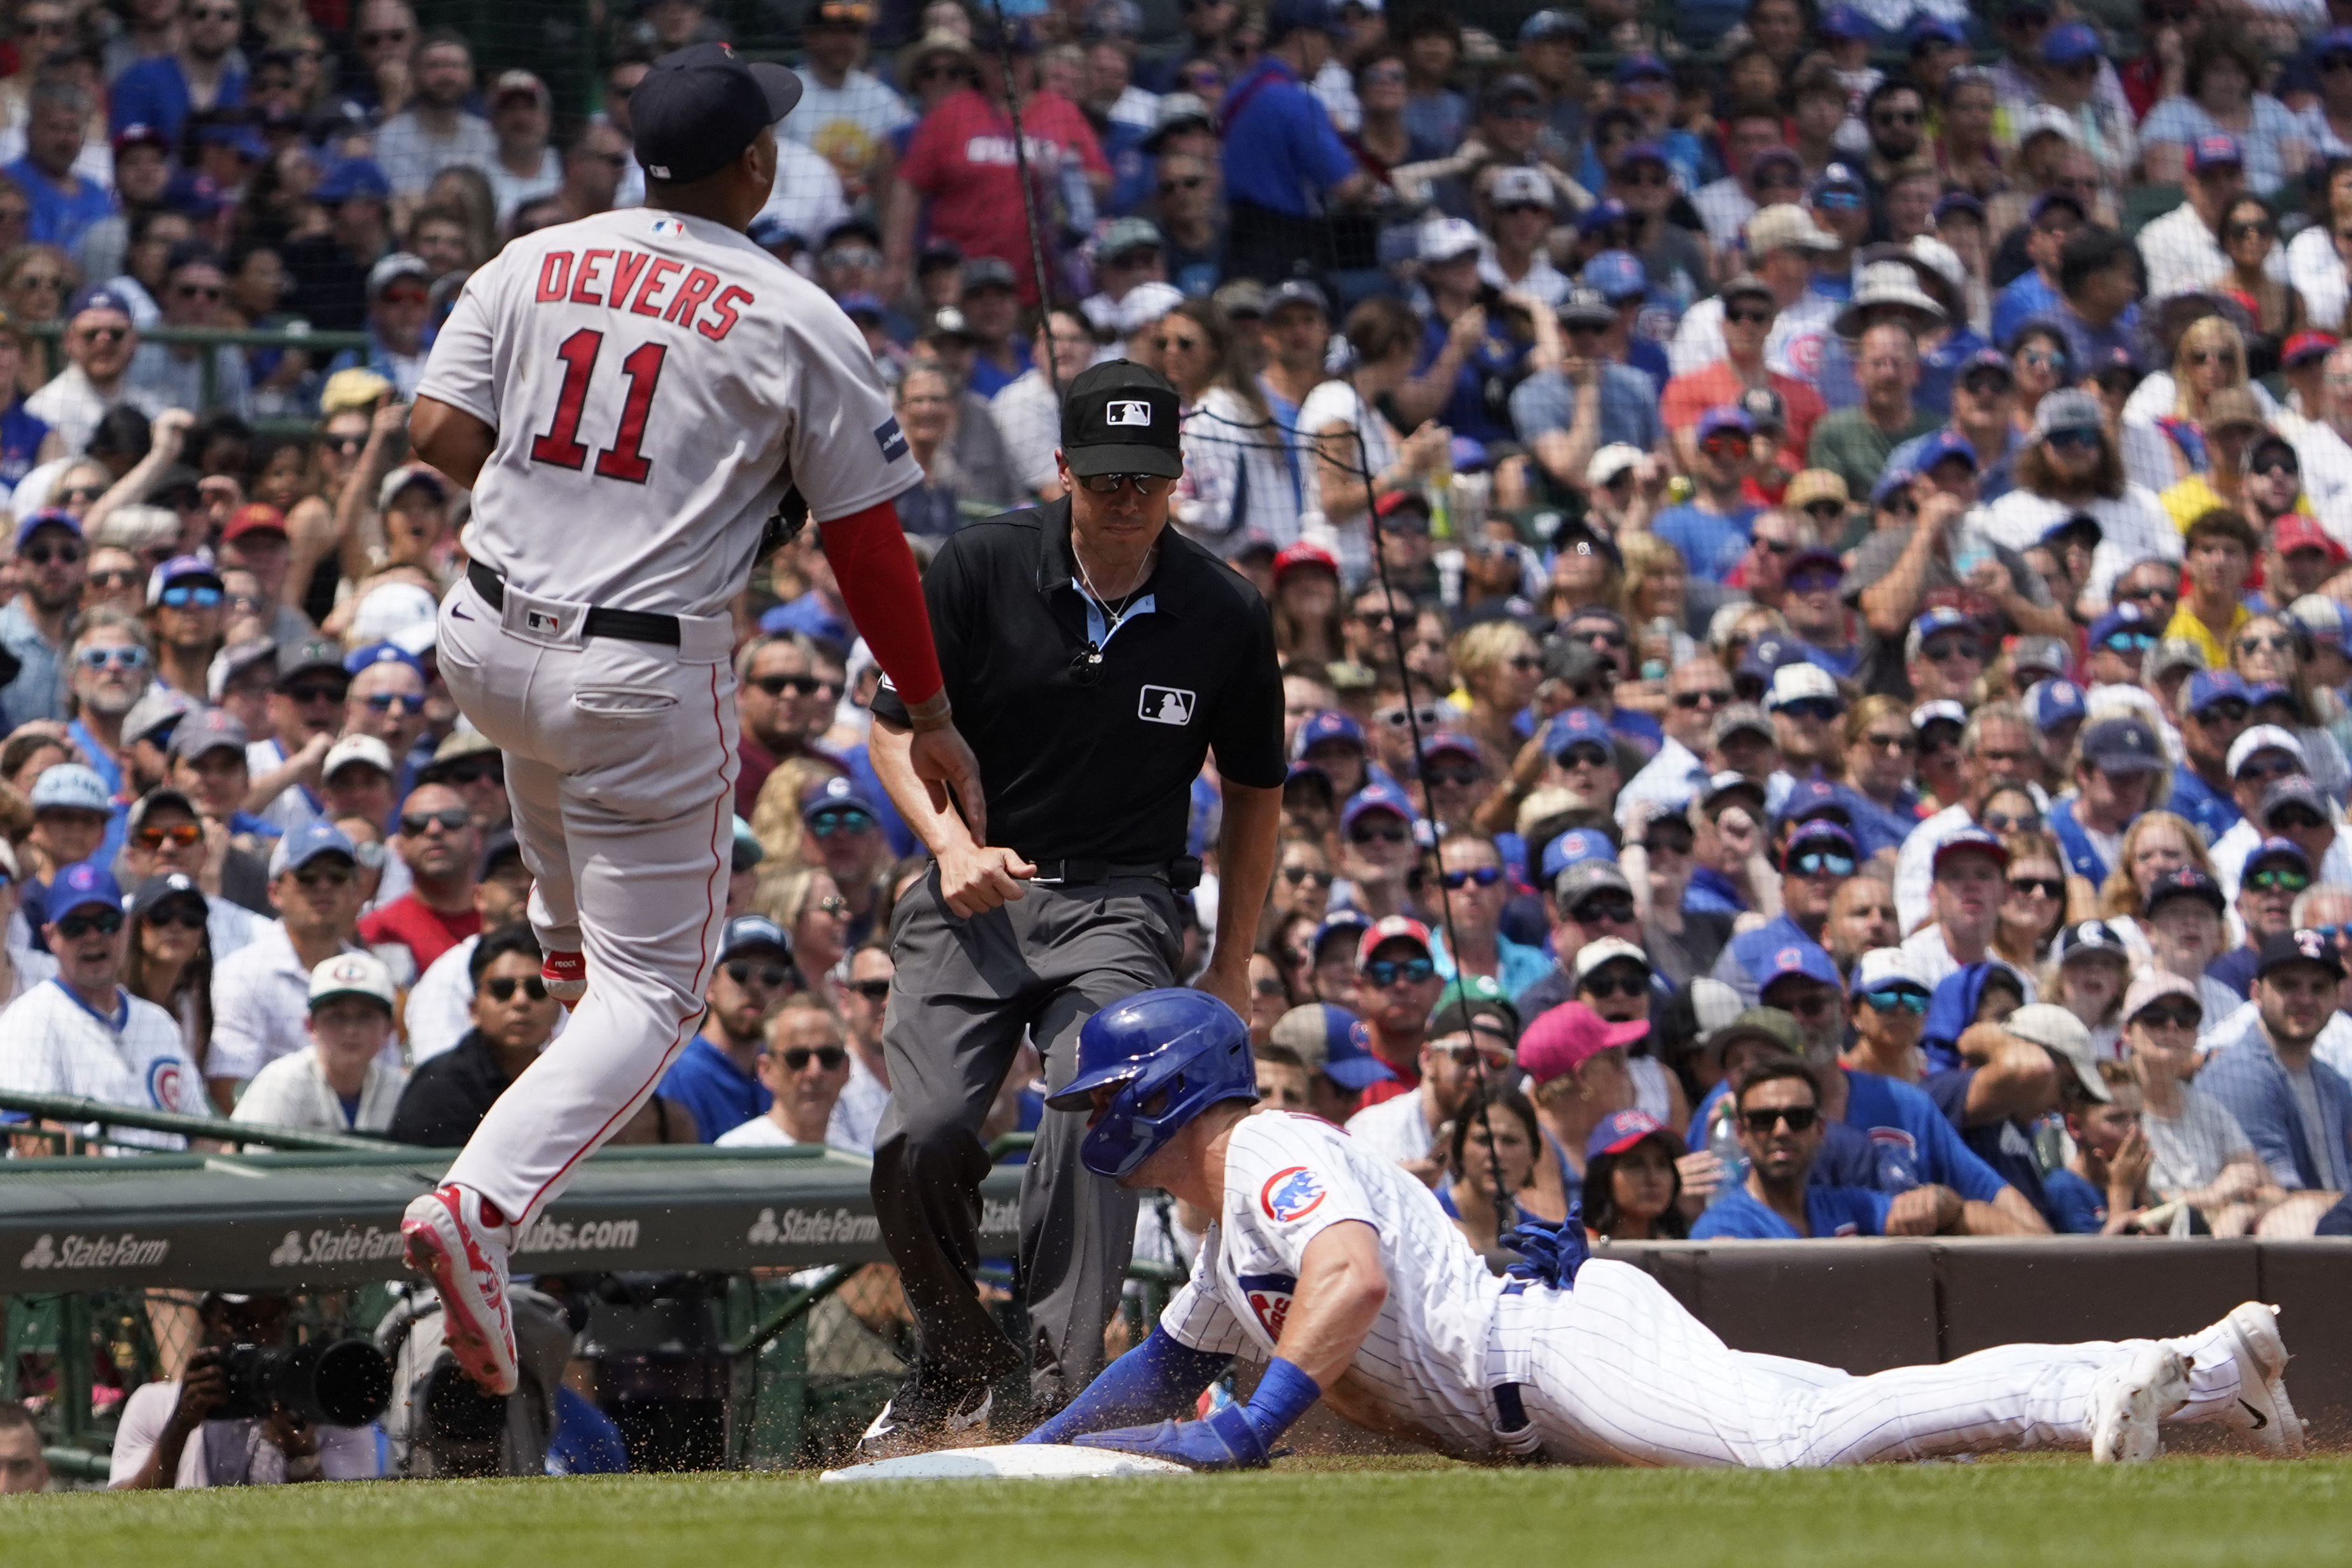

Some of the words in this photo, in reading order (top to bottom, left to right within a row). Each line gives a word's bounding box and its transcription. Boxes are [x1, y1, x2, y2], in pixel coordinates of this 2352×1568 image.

[535, 249, 755, 342] DEVERS
[530, 326, 668, 486] 11
[554, 959, 577, 967] react
[519, 1214, 640, 1254] ubs.com
[777, 1208, 881, 1243] StateFarm
[53, 1233, 170, 1269] StateFarm
